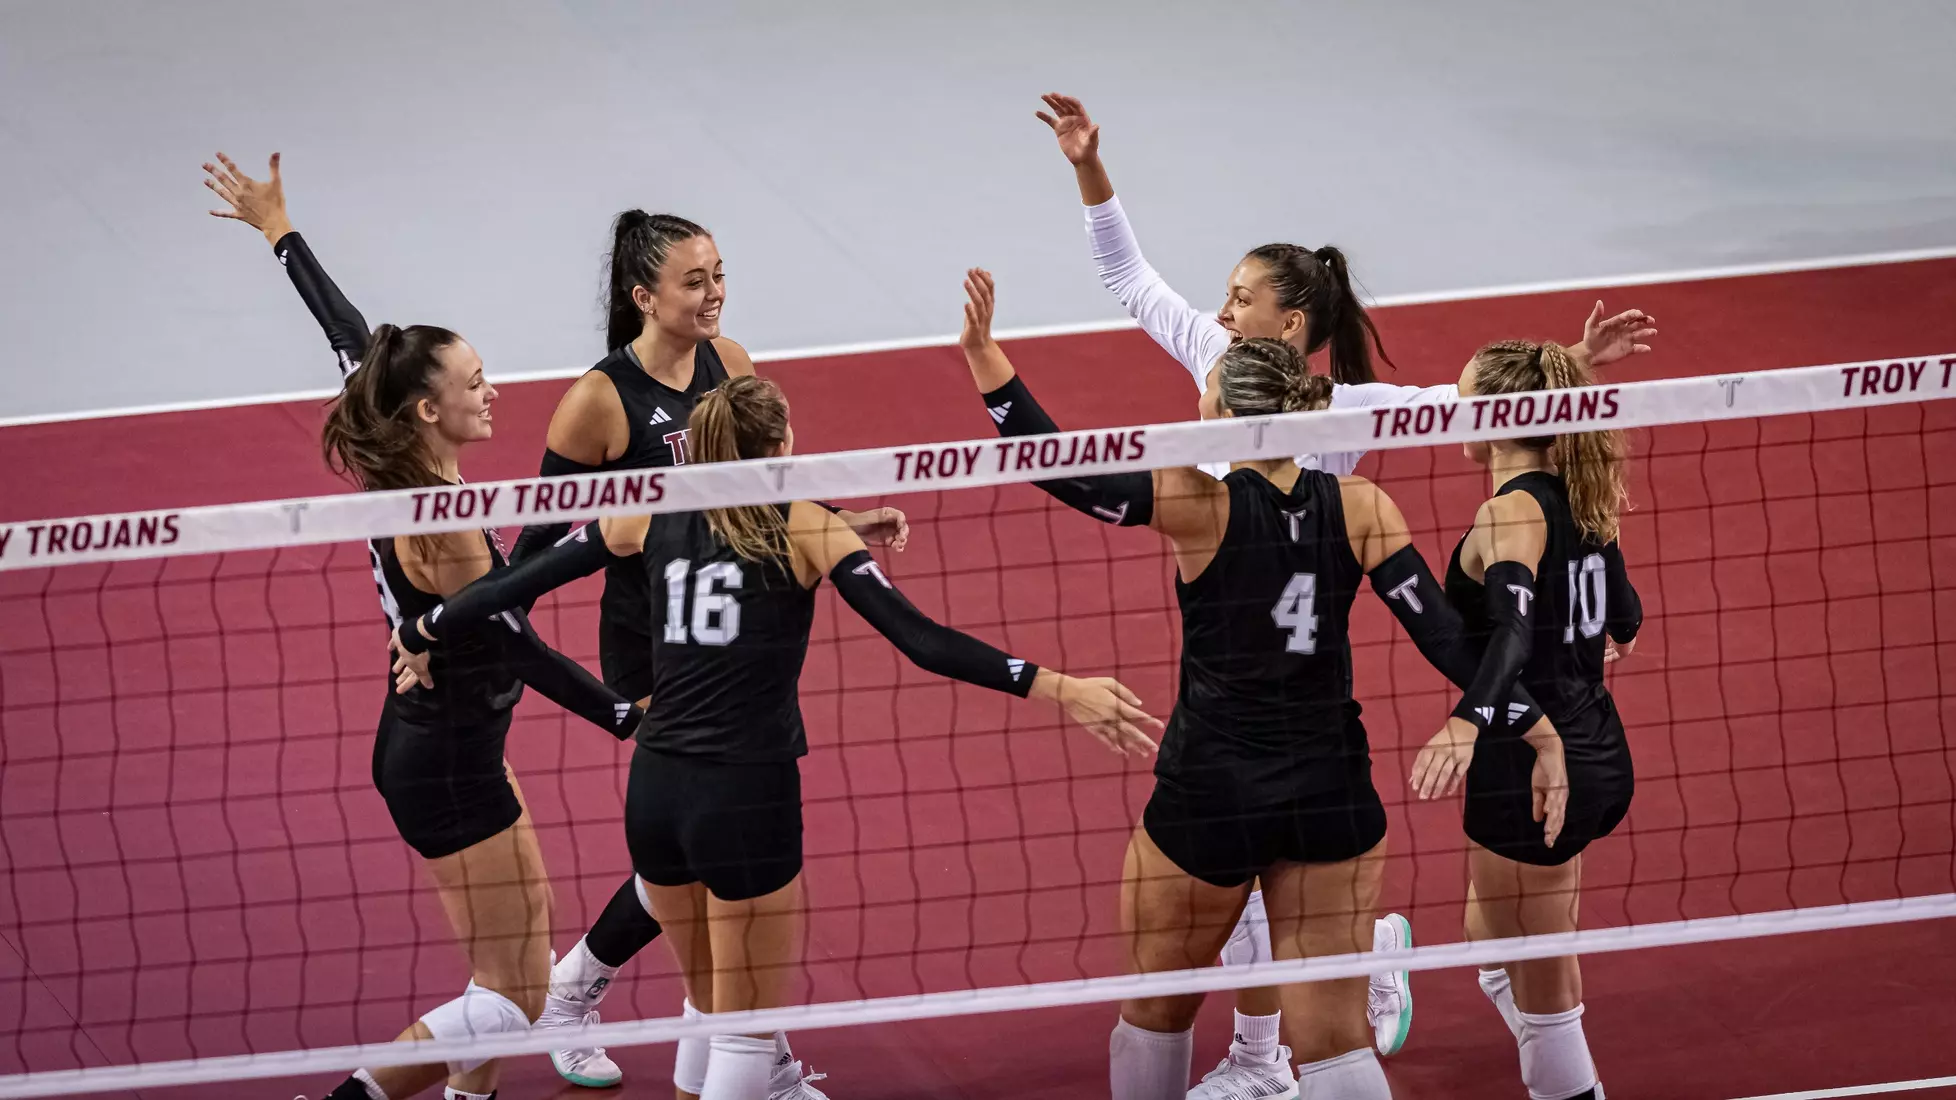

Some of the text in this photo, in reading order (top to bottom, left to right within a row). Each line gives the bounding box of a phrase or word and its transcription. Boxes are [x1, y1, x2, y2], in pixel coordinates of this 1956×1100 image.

[1841, 360, 1928, 397] TROY
[1371, 388, 1620, 438] TROY TROJANS
[894, 430, 1146, 482] TROY TROJANS
[411, 473, 666, 523] TROY TROJANS
[27, 514, 180, 557] TROJANS
[663, 558, 744, 647] 16
[1270, 572, 1319, 655] 4
[1563, 552, 1607, 644] 10
